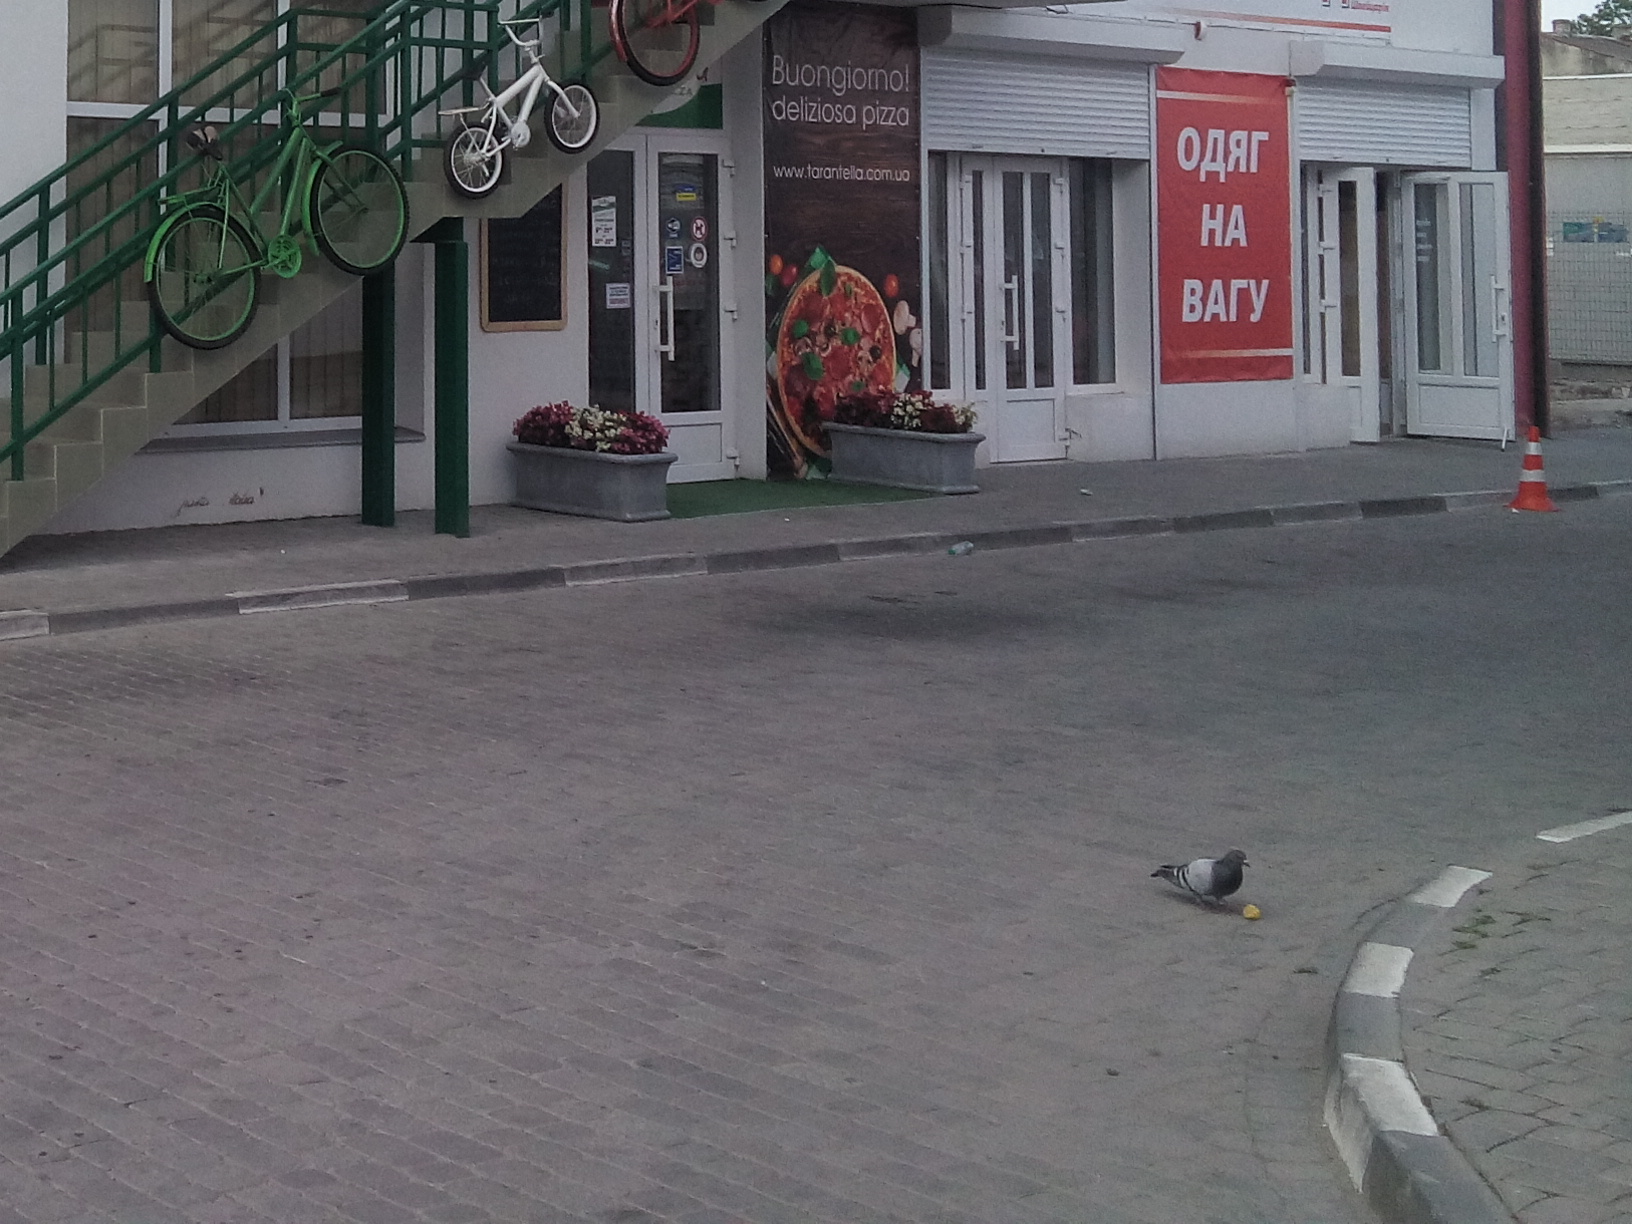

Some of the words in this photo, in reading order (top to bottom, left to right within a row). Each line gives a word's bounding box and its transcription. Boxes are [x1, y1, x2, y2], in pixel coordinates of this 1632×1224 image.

[772, 54, 909, 96] Buongiorno!
[772, 95, 857, 124] deliziosa
[862, 100, 910, 131] pizza
[773, 163, 910, 182] www.tarantella.com.ua
[1177, 126, 1270, 183] ОДЯГ
[1200, 203, 1248, 247] НА
[1182, 279, 1270, 323] ВАГУ
